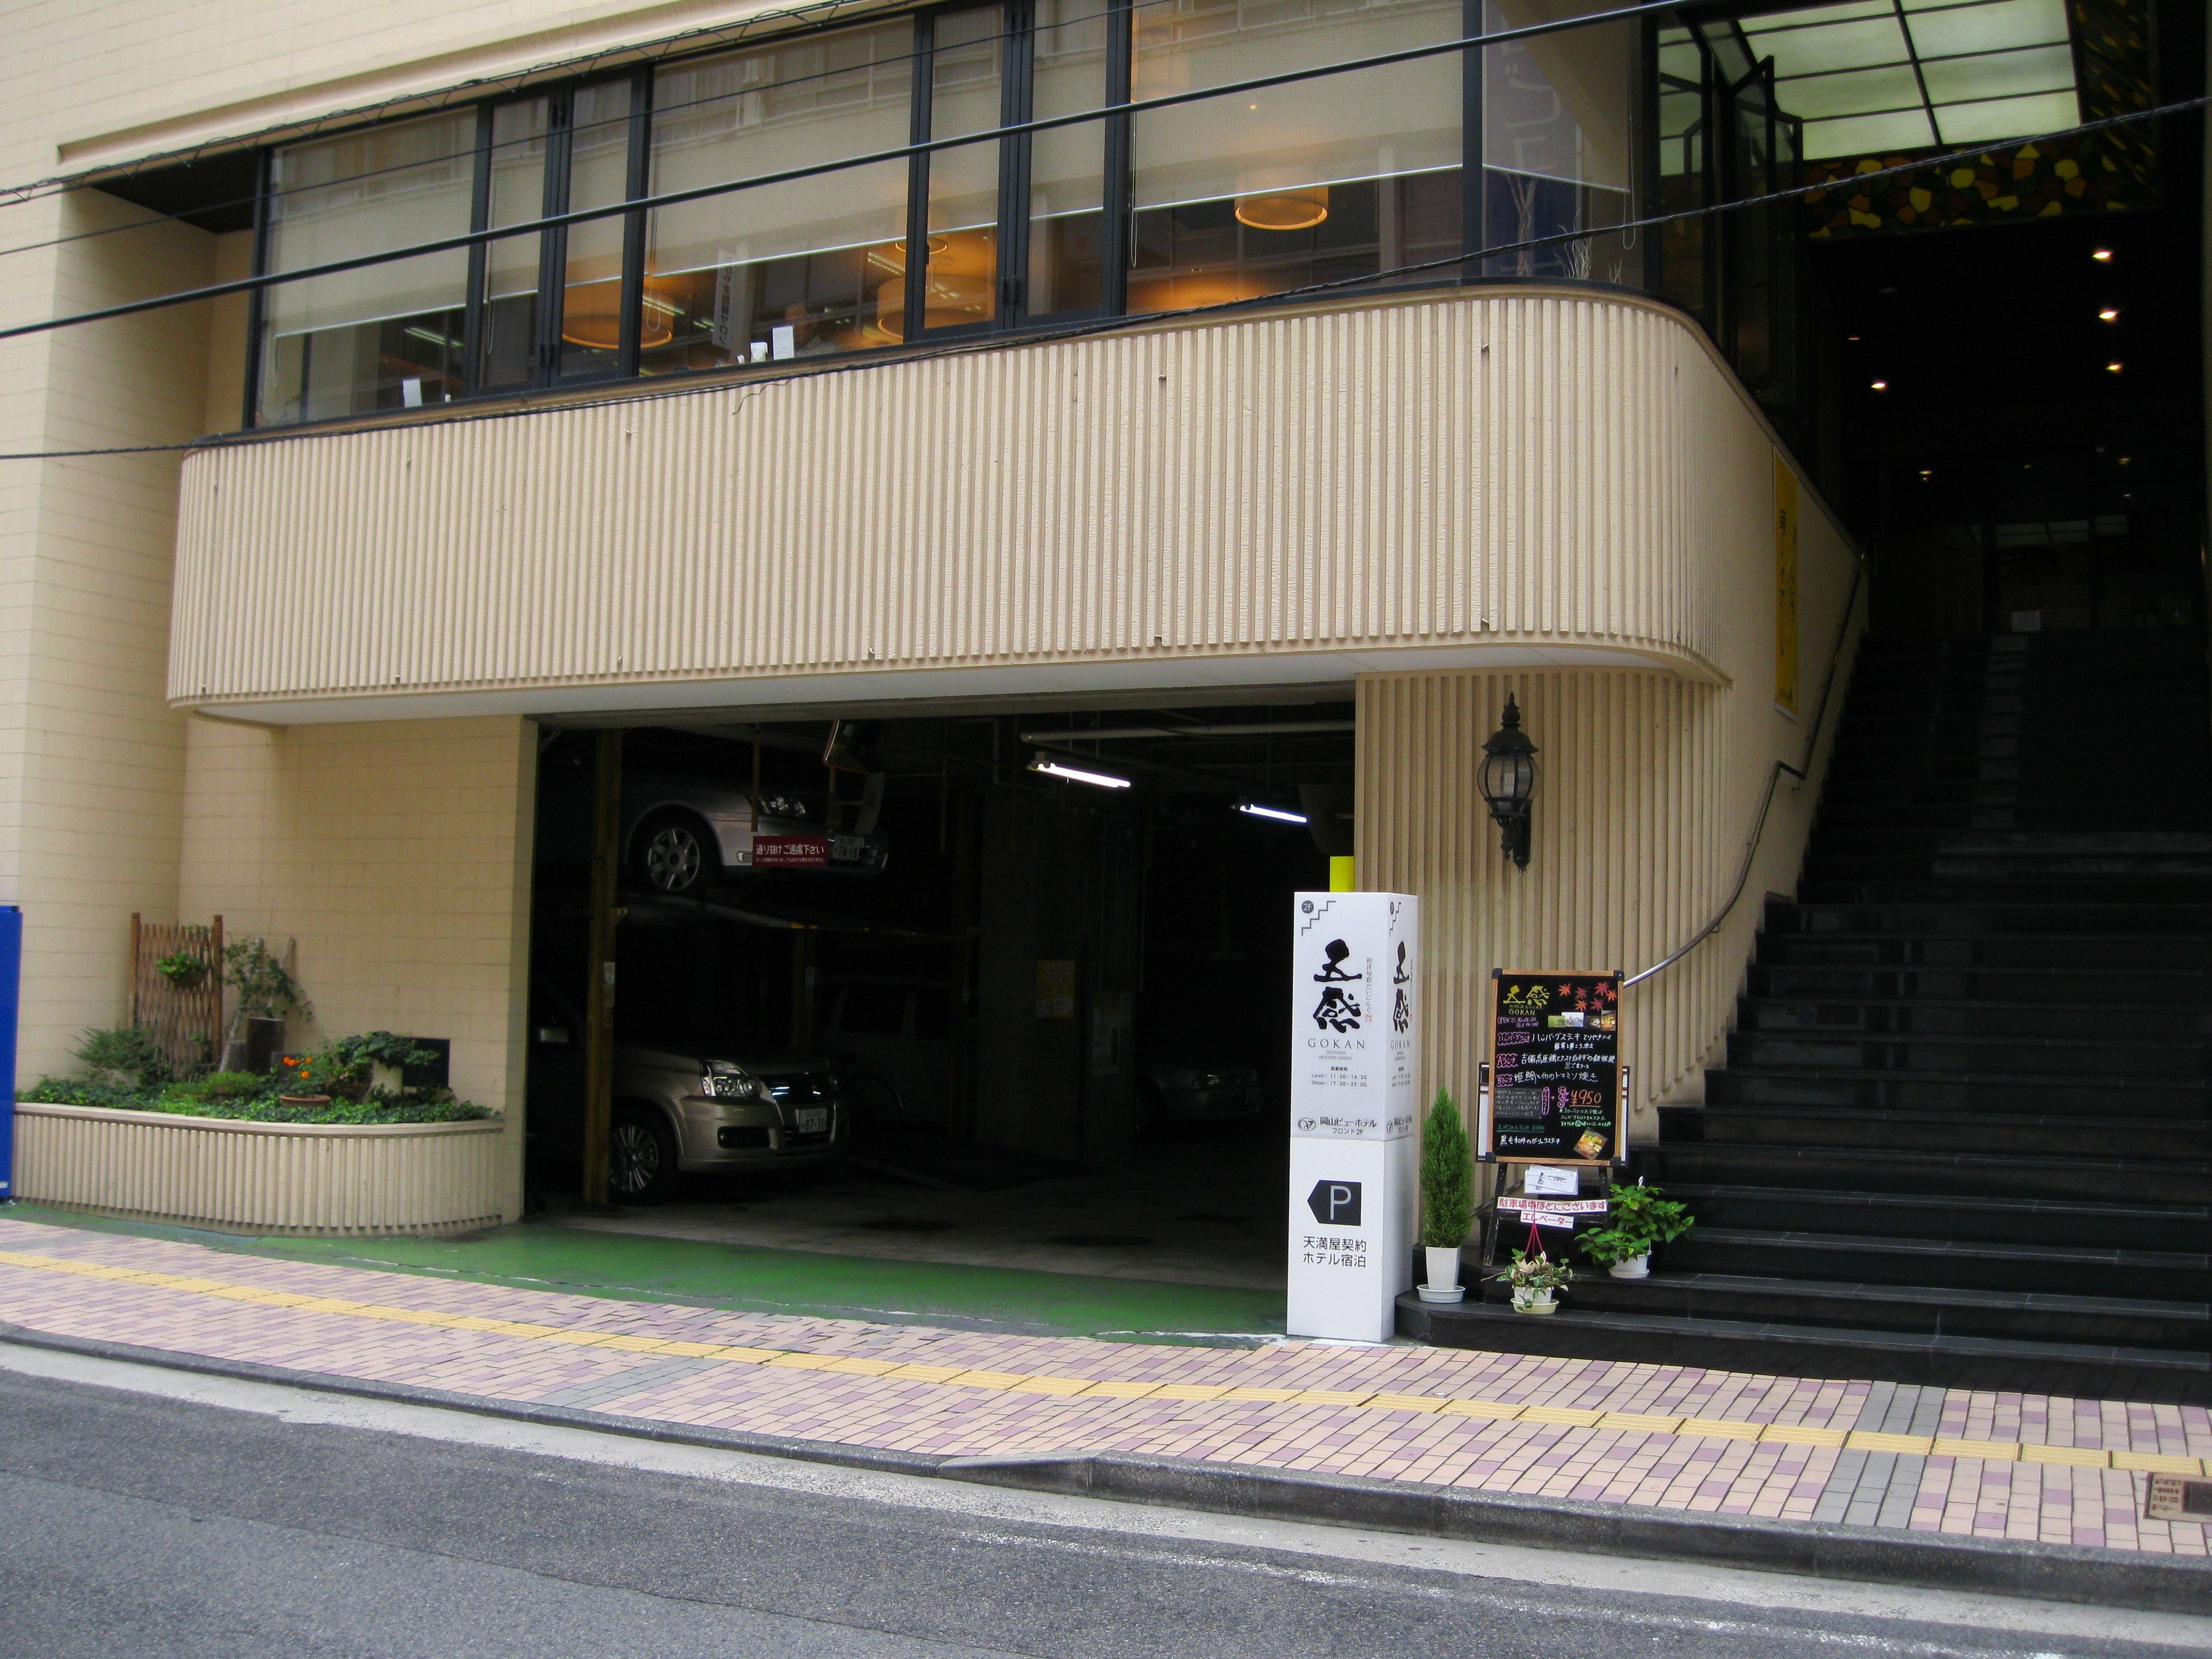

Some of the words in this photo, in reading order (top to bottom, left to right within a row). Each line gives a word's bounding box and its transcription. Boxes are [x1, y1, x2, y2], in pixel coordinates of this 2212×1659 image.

[1303, 903, 1313, 911] 2F
[1532, 1032, 1580, 1042] ハンバーグステーキ
[1308, 1038, 1365, 1049] GOKAN
[1391, 1039, 1411, 1050] GOKAN
[805, 1118, 825, 1131] 87-30
[1320, 1116, 1377, 1128] 岡山ビューホテル
[1332, 1127, 1363, 1135] フロント2F
[1330, 1184, 1352, 1221] P
[1499, 1198, 1607, 1212] 駐車場中ほどにございます
[1522, 1212, 1574, 1226] エレベーター
[1303, 1235, 1367, 1252] 天満屋契約
[1302, 1252, 1367, 1268] ホテル宿泊
